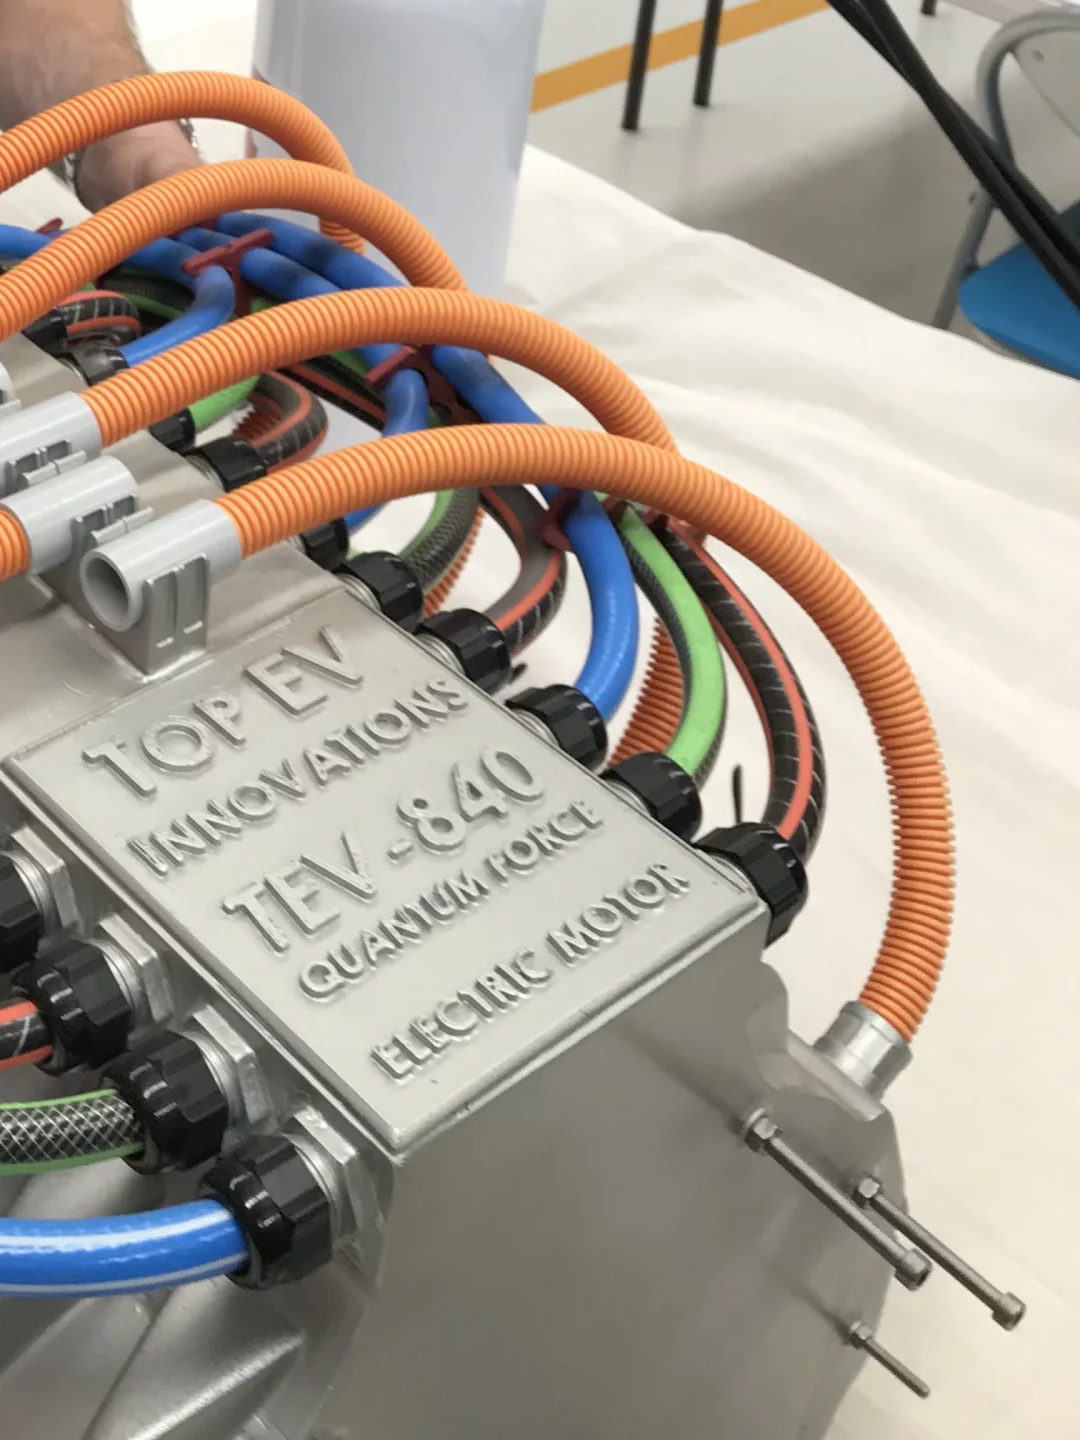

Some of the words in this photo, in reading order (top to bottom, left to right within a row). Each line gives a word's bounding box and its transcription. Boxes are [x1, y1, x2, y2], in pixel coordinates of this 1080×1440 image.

[81, 690, 248, 799] TOP
[242, 626, 364, 720] EV
[126, 677, 470, 878] INNOVATIONS
[220, 830, 379, 955] TEV
[298, 867, 491, 1002] QUANTUM
[483, 798, 605, 886] FORCE
[368, 947, 553, 1086] ELECTRIC
[545, 862, 693, 967] MOTOR
